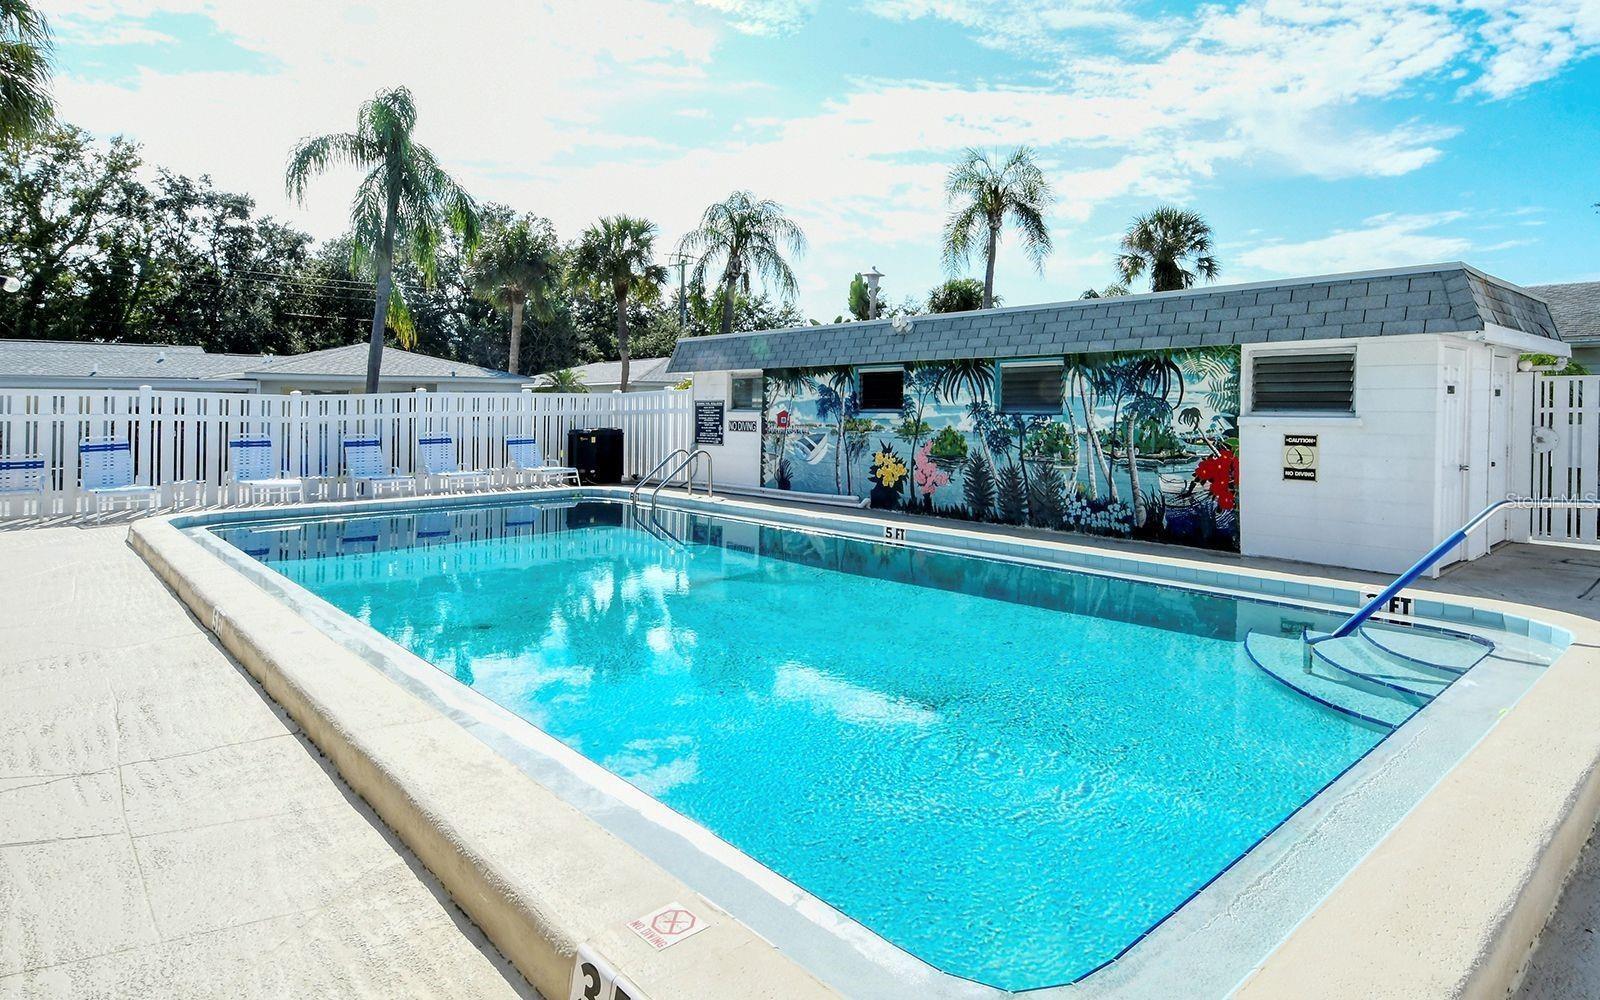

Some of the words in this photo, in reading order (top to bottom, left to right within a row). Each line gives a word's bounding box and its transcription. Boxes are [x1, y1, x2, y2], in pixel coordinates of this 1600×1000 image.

[729, 421, 738, 431] NO
[738, 421, 758, 431] DIVING
[885, 526, 893, 538] 5
[895, 528, 905, 540] FT
[1389, 596, 1412, 615] FT
[640, 928, 667, 949] DIVING
